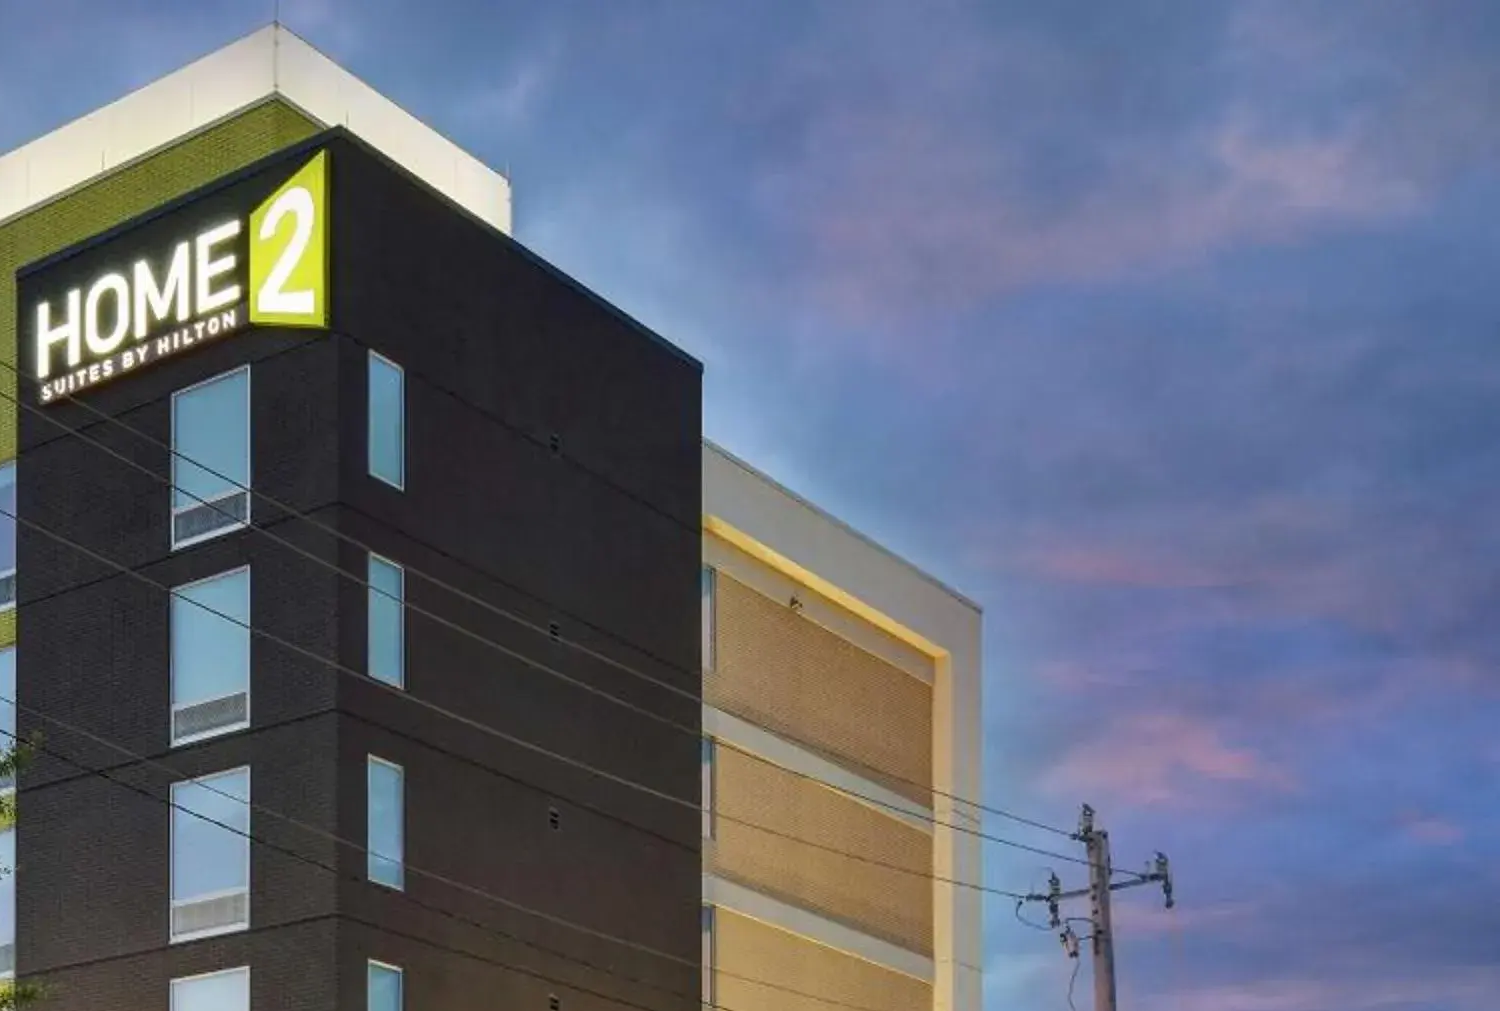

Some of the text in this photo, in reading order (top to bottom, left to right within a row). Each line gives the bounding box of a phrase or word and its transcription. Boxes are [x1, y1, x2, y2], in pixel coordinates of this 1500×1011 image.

[36, 186, 315, 379] HOME 2
[41, 309, 236, 401] SUITES BY HILTON
